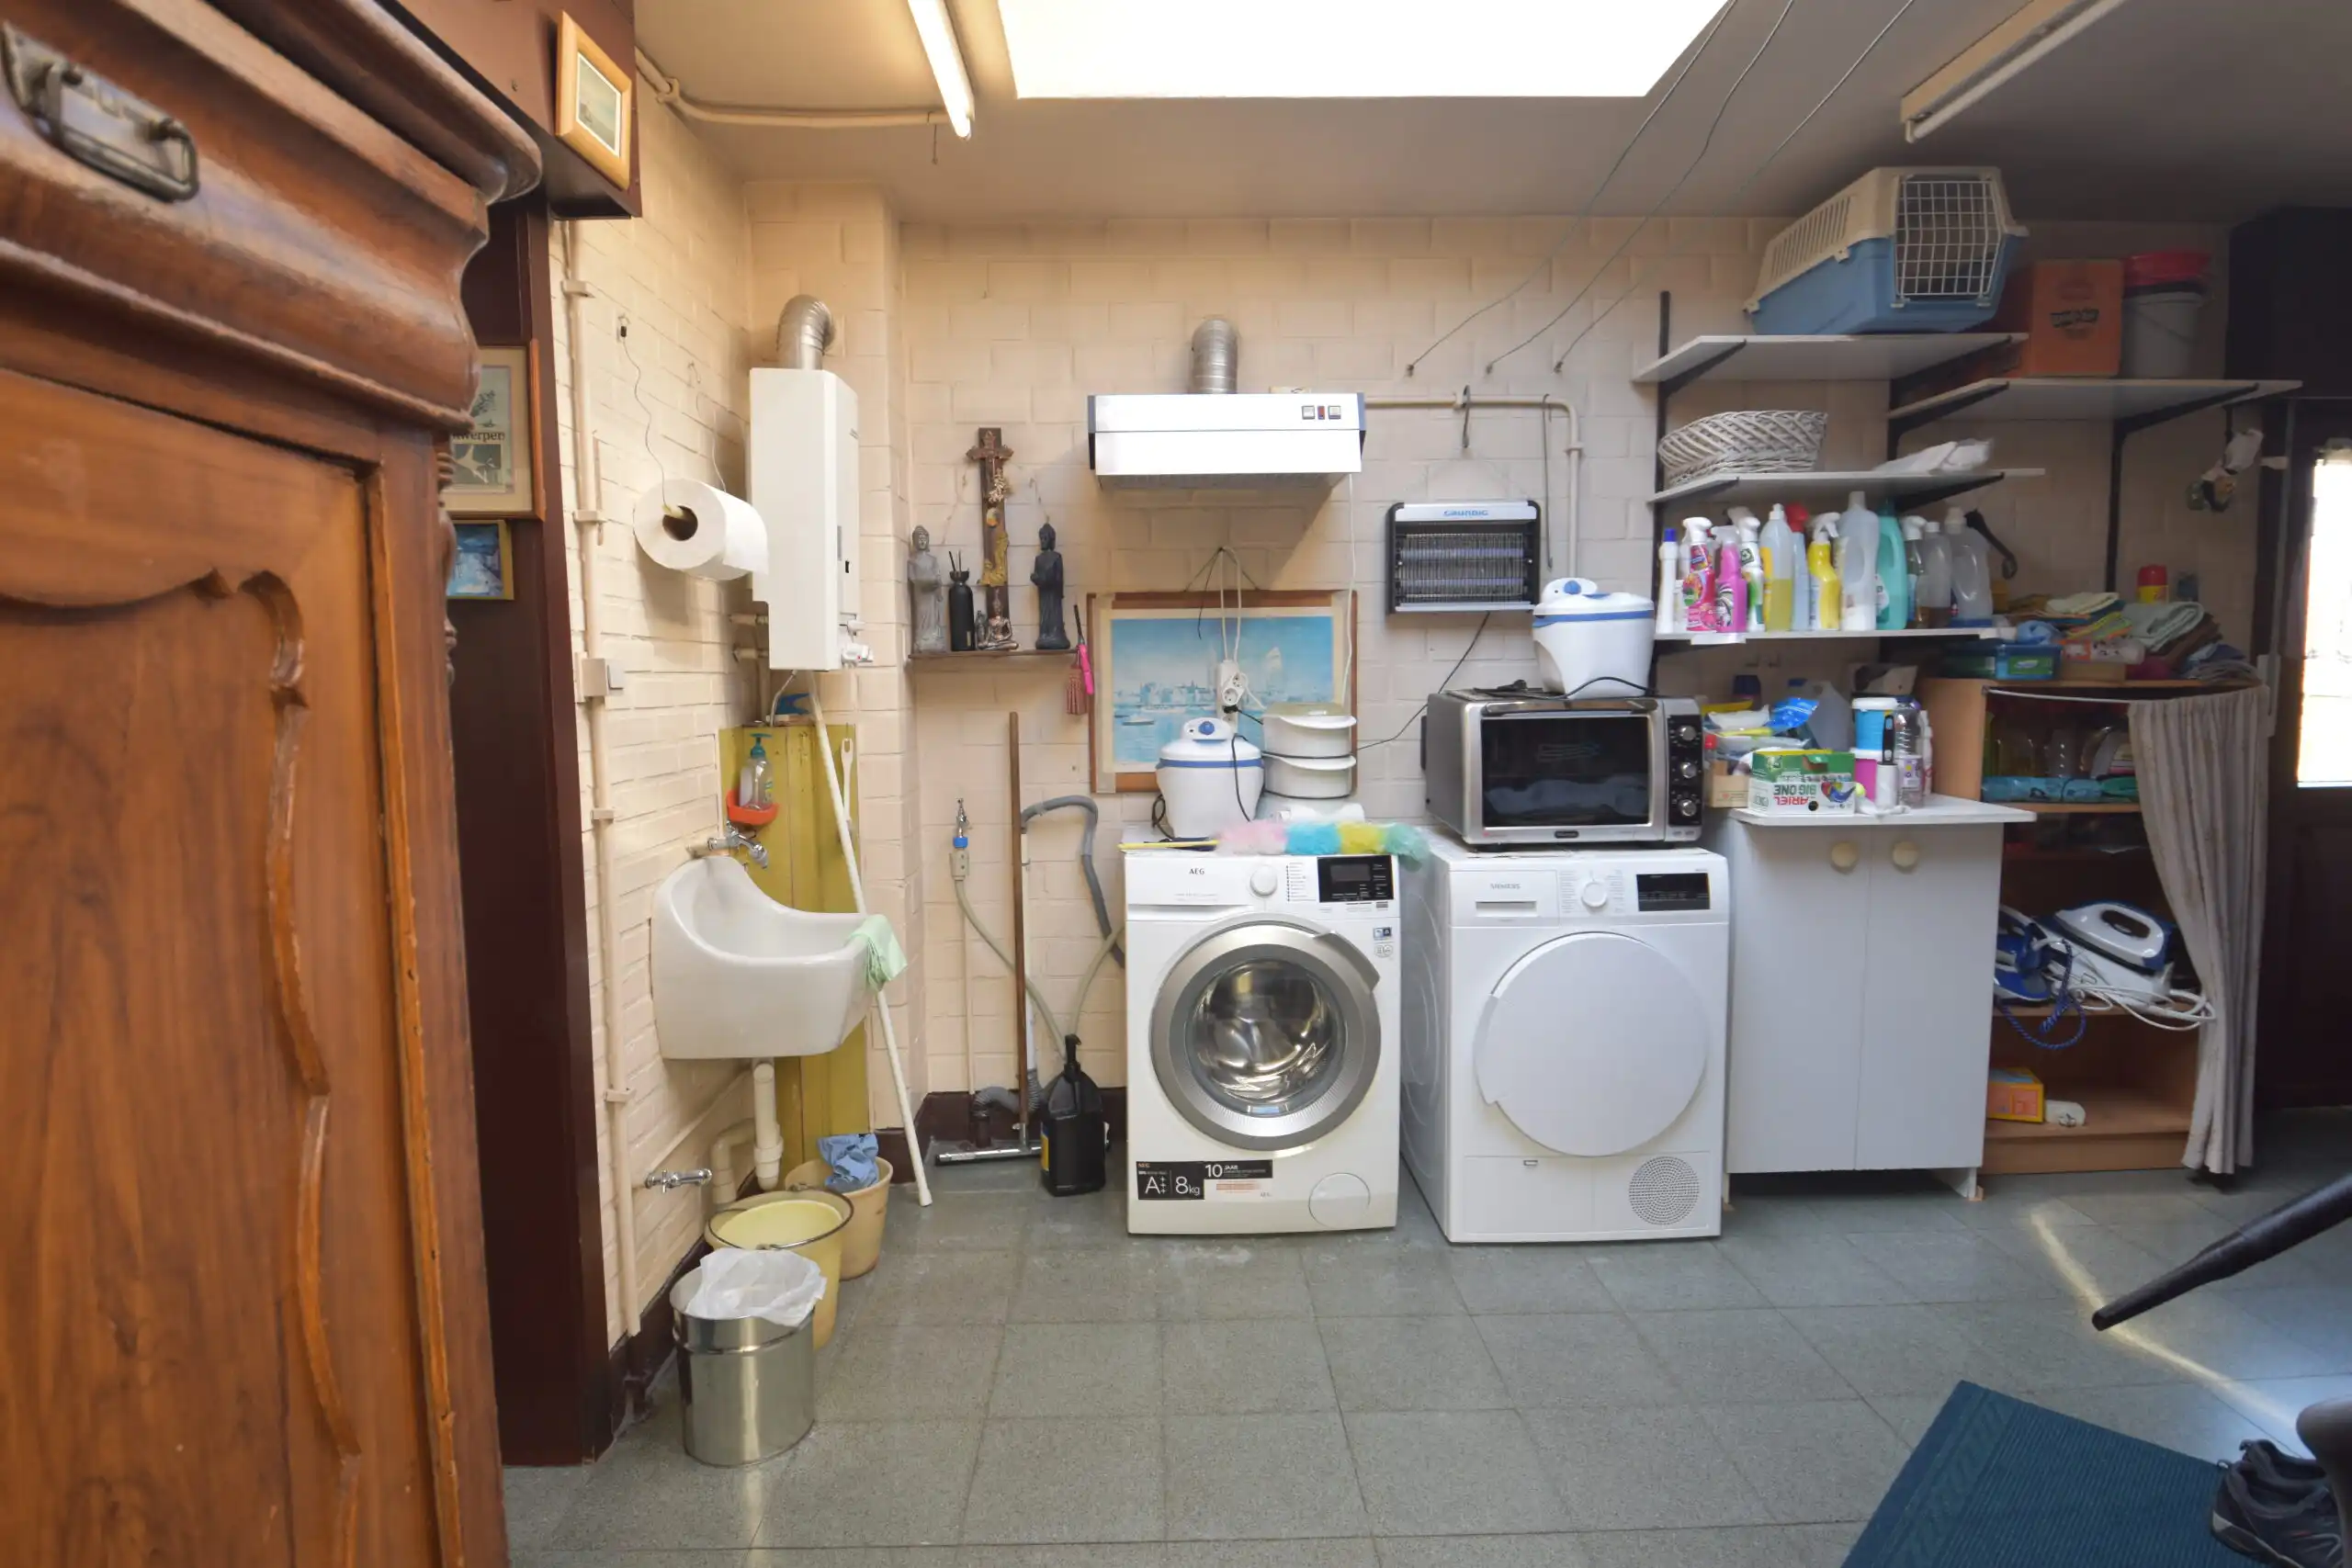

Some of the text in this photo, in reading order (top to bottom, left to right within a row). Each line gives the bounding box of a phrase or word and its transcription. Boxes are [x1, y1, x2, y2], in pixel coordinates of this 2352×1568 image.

[1774, 784, 1816, 795] BIG ONE
[1773, 796, 1809, 806] ARIEL
[1205, 1164, 1223, 1178] 10
